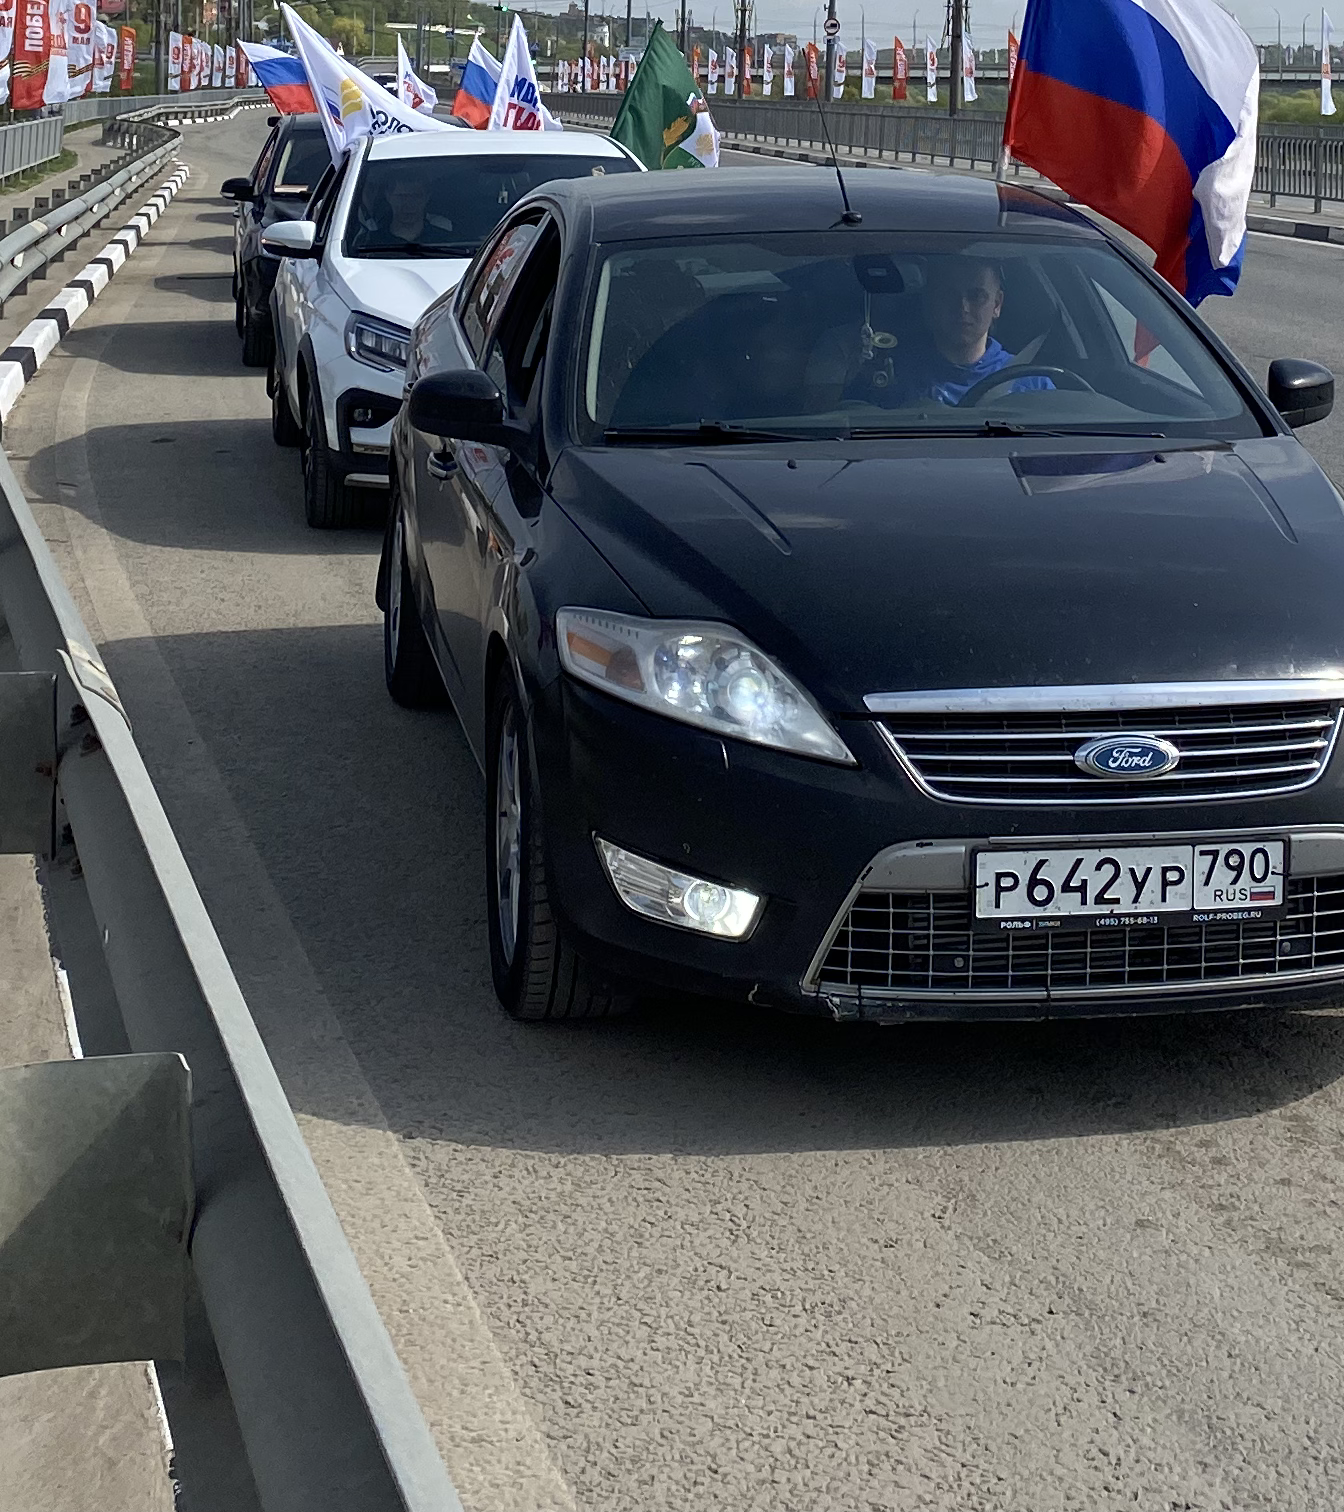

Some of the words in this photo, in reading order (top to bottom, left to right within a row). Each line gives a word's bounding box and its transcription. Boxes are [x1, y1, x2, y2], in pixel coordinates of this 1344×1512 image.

[74, 2, 92, 35] 9
[71, 35, 91, 46] МАЯ
[1107, 747, 1154, 769] Ford
[993, 857, 1186, 910] Р642УР
[1199, 846, 1271, 887] 790
[1213, 888, 1248, 903] RUS
[1000, 920, 1032, 929] РОЛЬФ
[1095, 917, 1119, 927] (495)
